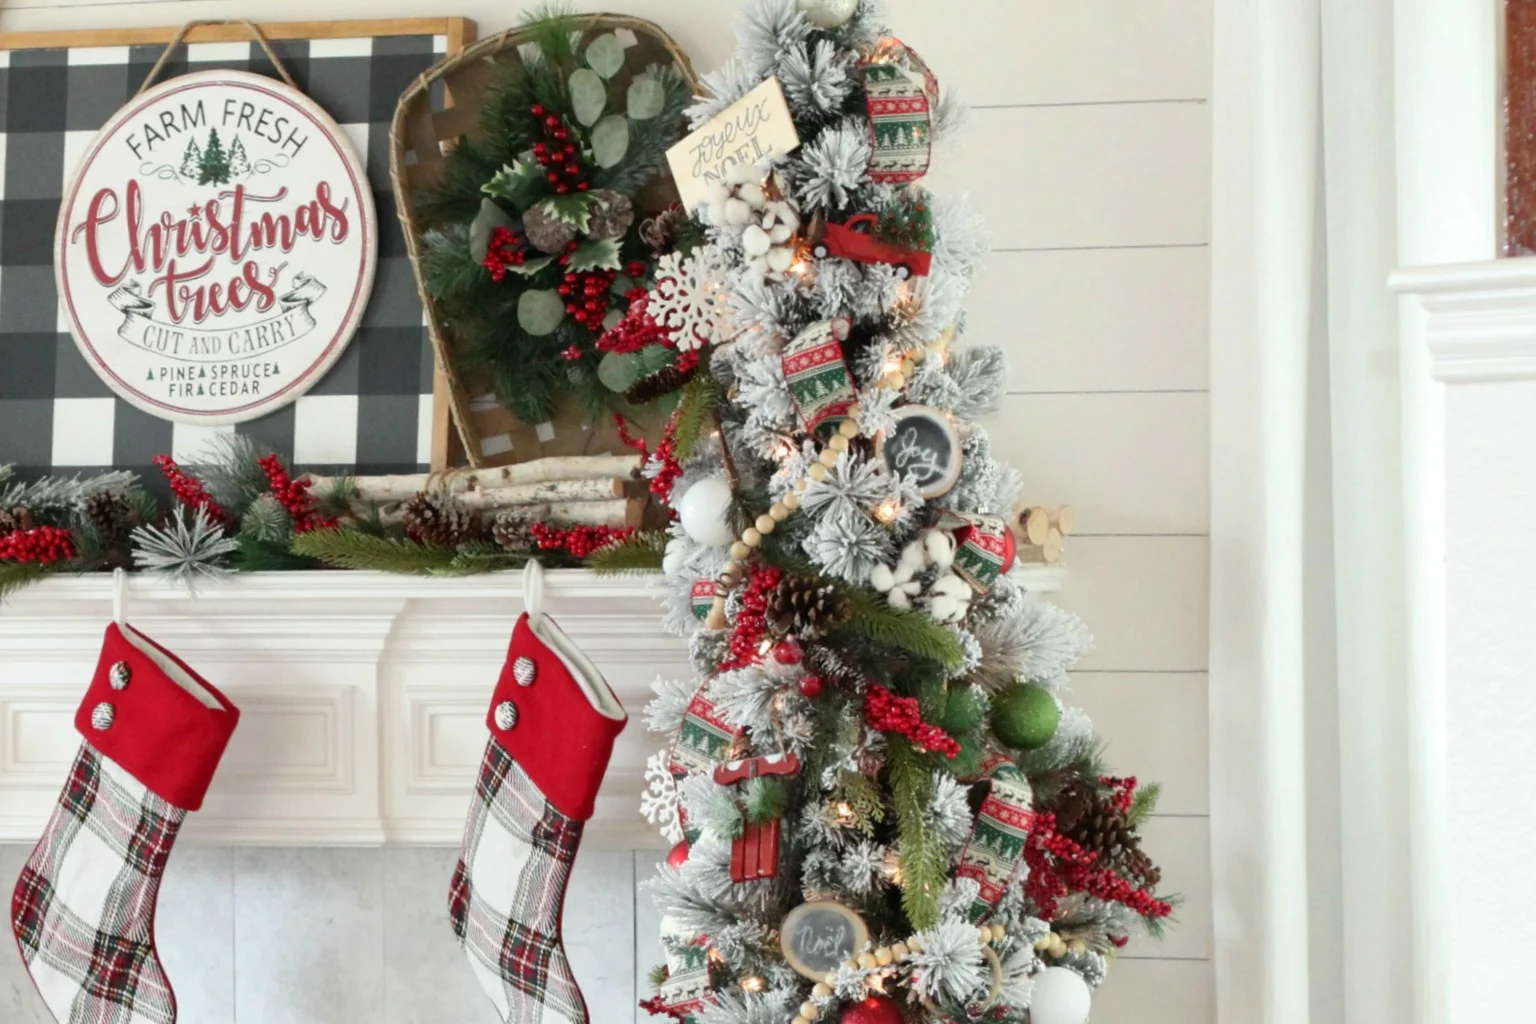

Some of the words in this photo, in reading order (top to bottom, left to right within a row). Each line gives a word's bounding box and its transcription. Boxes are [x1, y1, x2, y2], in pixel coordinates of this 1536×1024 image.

[125, 99, 206, 160] FARM
[222, 98, 309, 159] FRESH
[689, 98, 771, 178] Joyeux
[72, 179, 349, 287] Christmas
[148, 258, 288, 325] trees
[142, 324, 185, 355] CUT
[188, 336, 222, 355] AND
[228, 314, 297, 355] CARRY
[160, 366, 196, 382] PINE
[211, 363, 272, 379] SPRUCE
[169, 383, 194, 398] FIR
[209, 380, 261, 396] CEDAR
